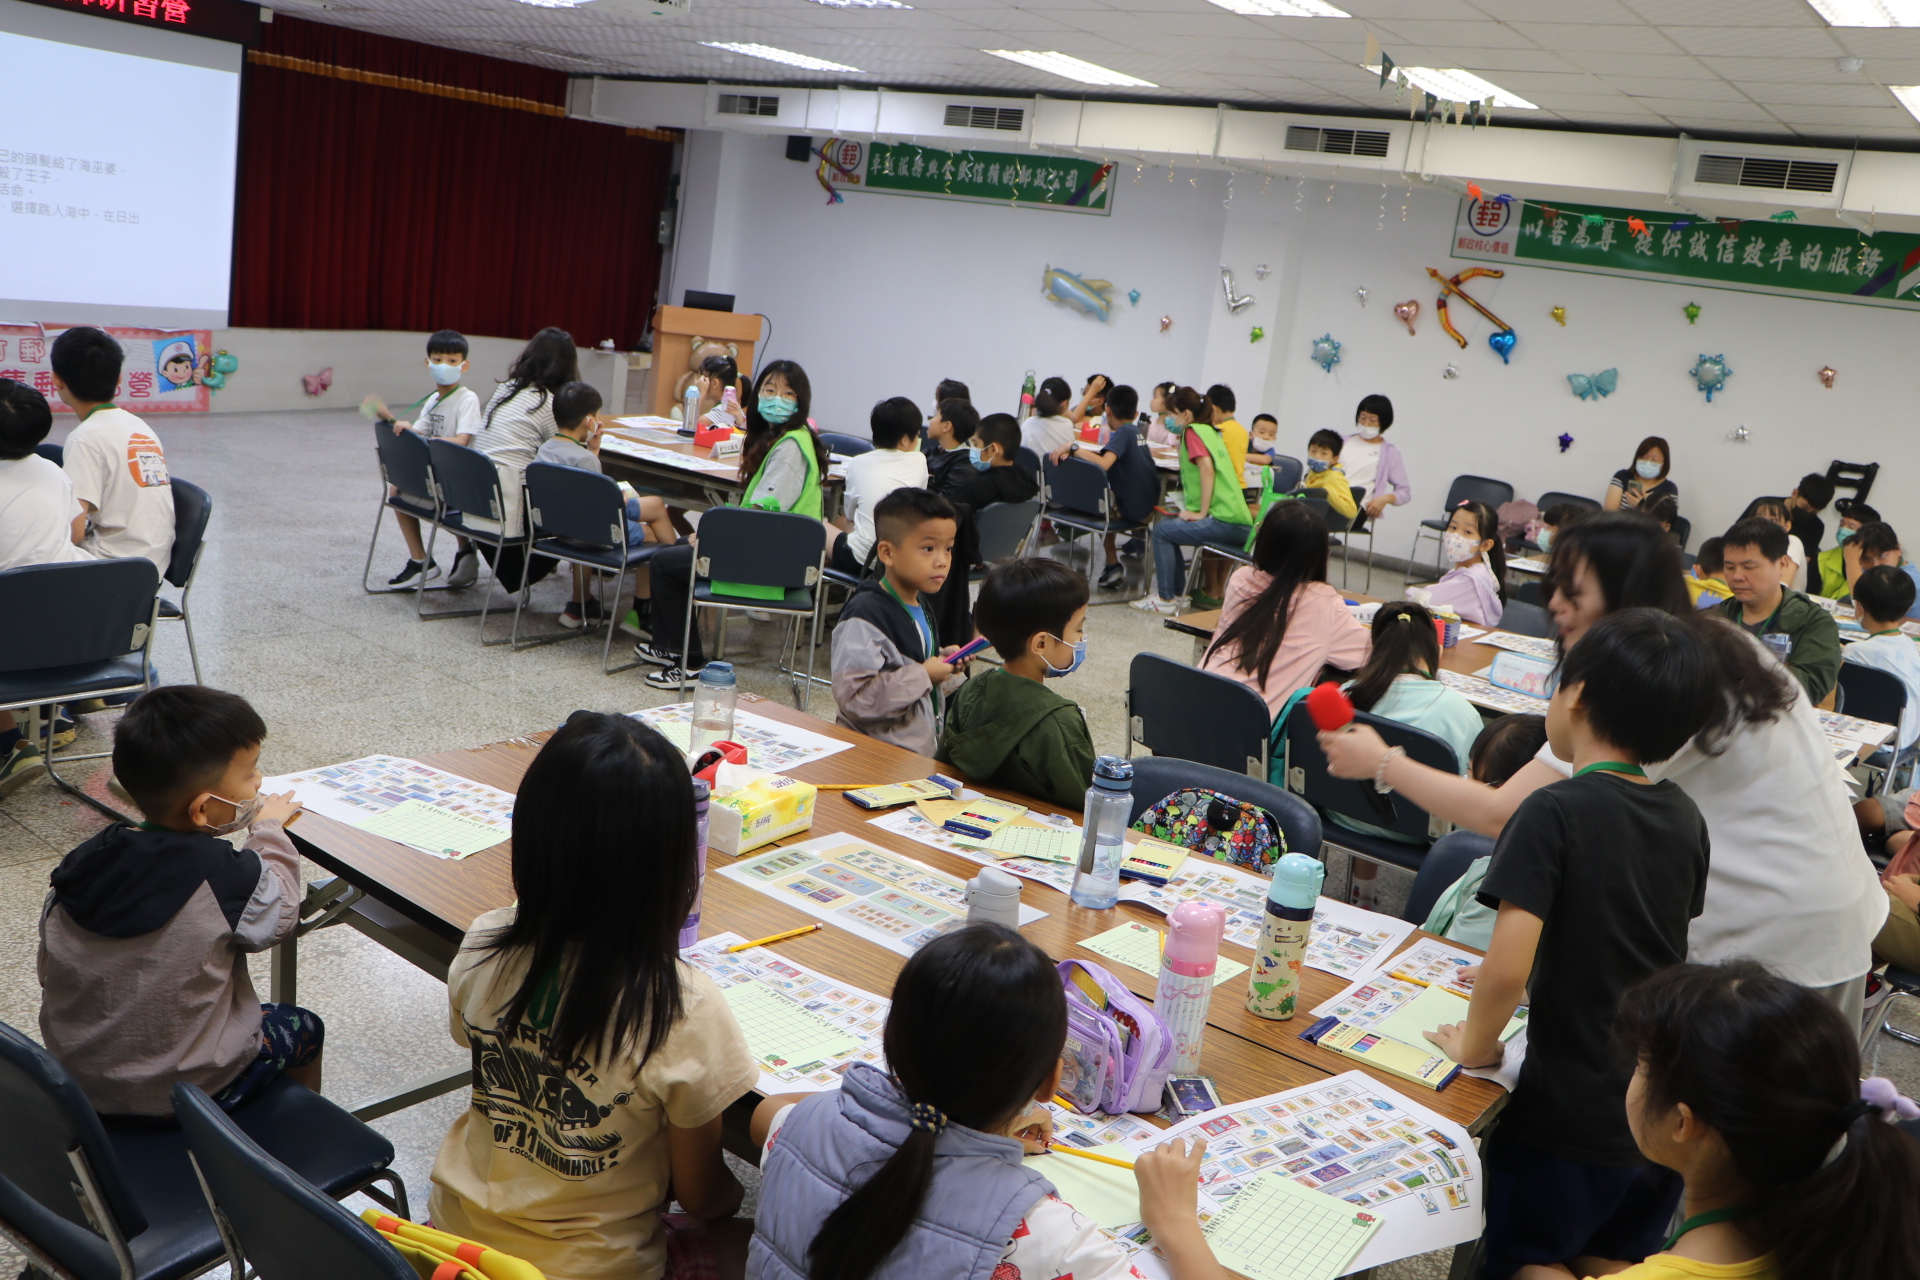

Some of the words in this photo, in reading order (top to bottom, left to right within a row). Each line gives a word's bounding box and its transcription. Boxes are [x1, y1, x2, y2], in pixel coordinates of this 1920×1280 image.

[1475, 200, 1503, 228] 郵
[1457, 237, 1510, 255] 郵政核心價值
[493, 1123, 514, 1143] OF
[535, 1140, 606, 1177] WORMHOLE
[509, 1146, 535, 1164] COCOON
